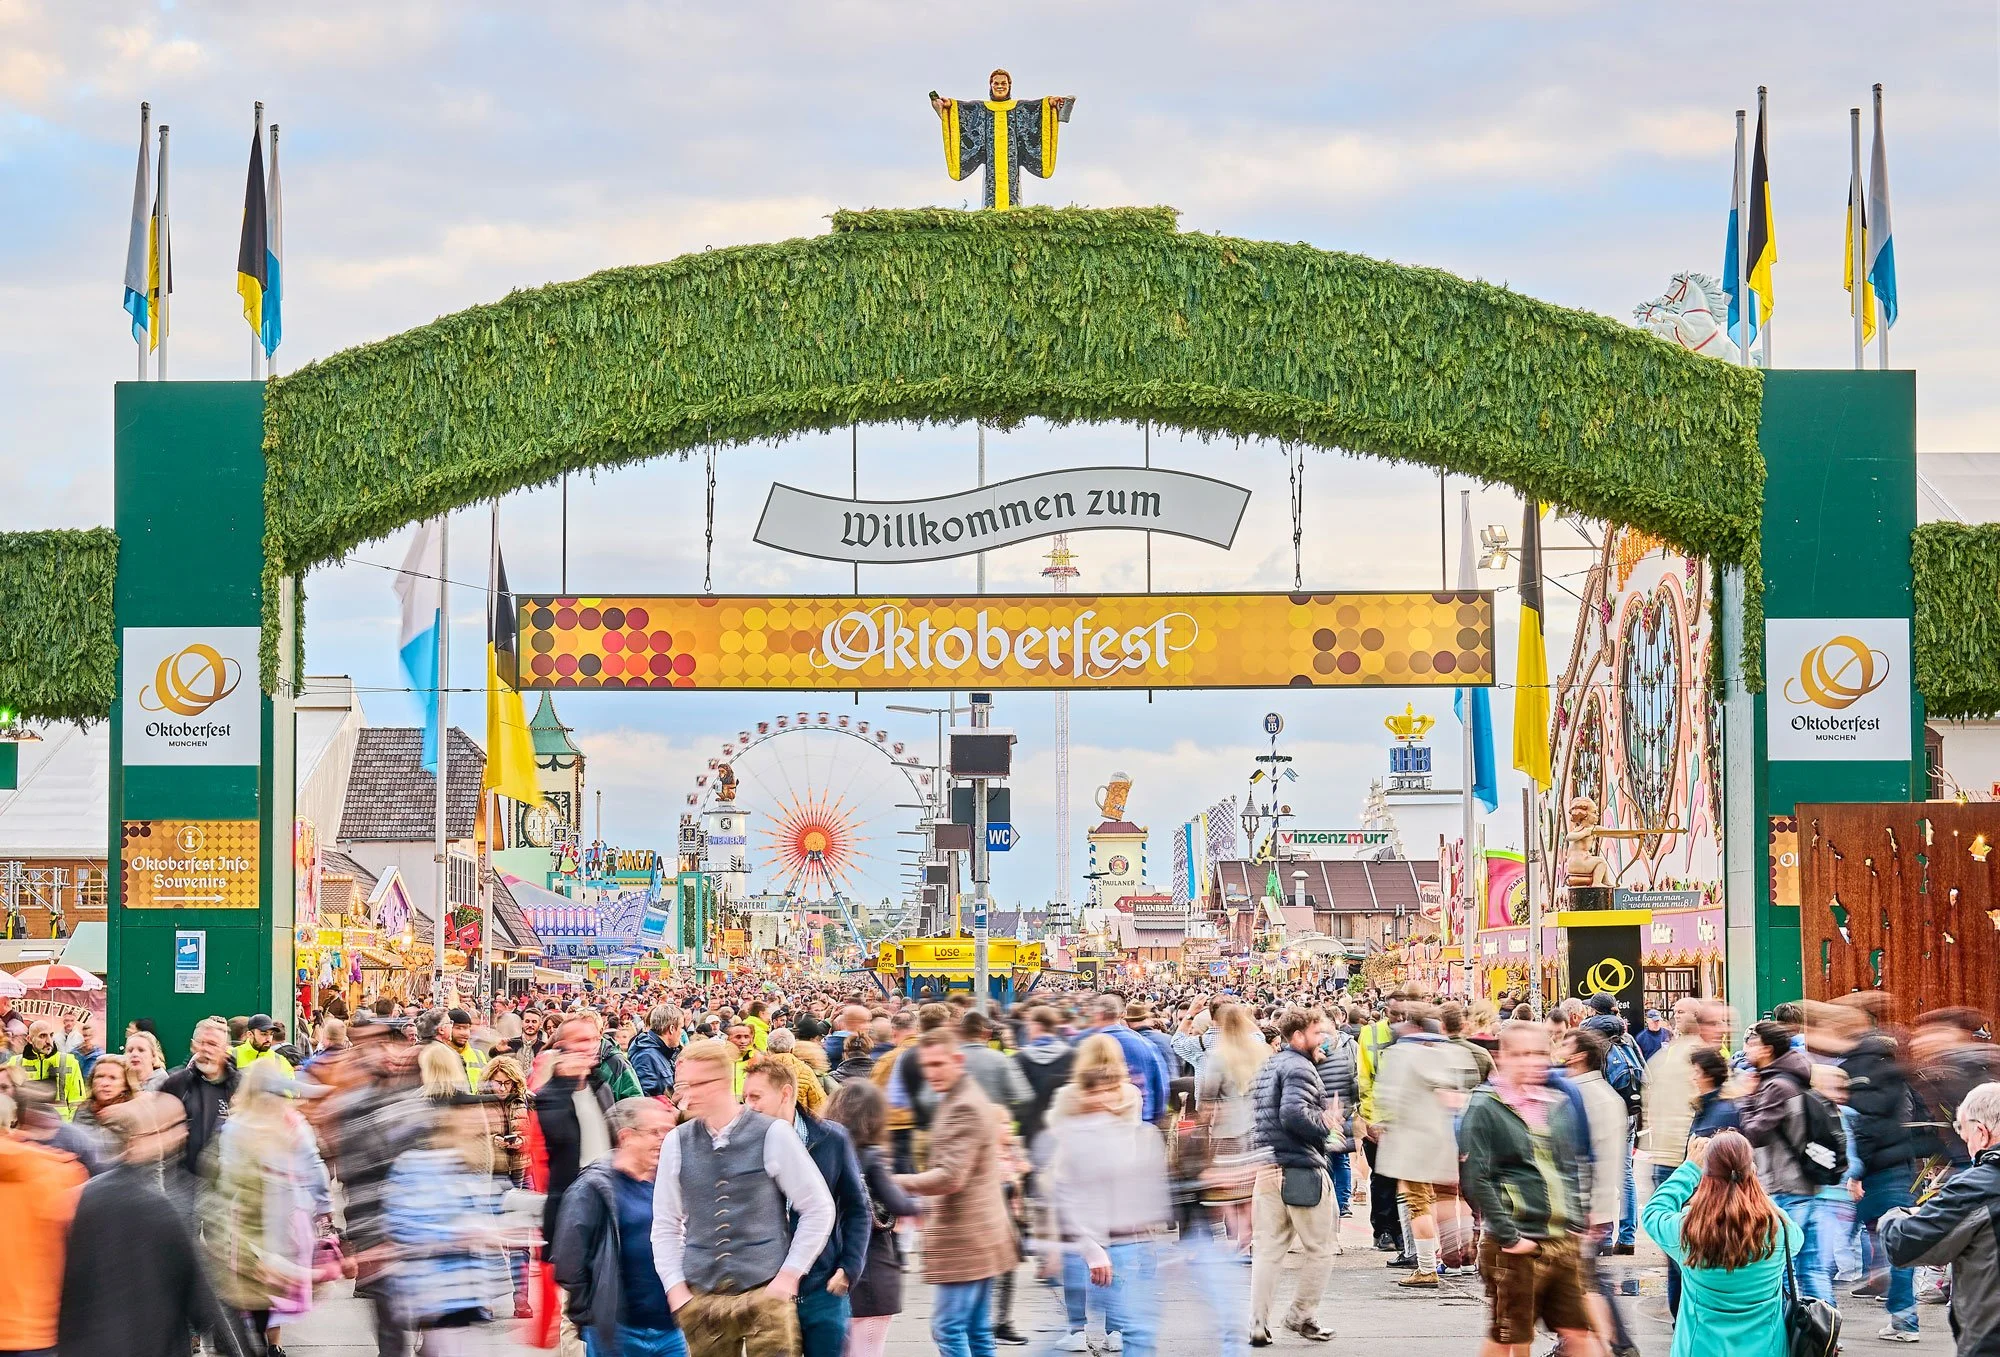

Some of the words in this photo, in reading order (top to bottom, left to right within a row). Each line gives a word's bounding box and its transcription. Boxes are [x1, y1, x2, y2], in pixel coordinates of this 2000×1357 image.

[840, 489, 1076, 548] Willkommen
[1086, 487, 1161, 518] zum
[808, 604, 1199, 680] Oktoberfest
[145, 722, 231, 737] Oktoberfest
[1790, 715, 1881, 732] Oktoberfest
[988, 829, 1010, 845] WC
[1281, 830, 1389, 845] vinzenzmurr
[131, 857, 216, 874] Oktoberfest
[217, 856, 249, 872] Info
[153, 873, 227, 889] Souvenirs
[1102, 879, 1135, 887] PAULANER
[934, 946, 960, 957] Lose
